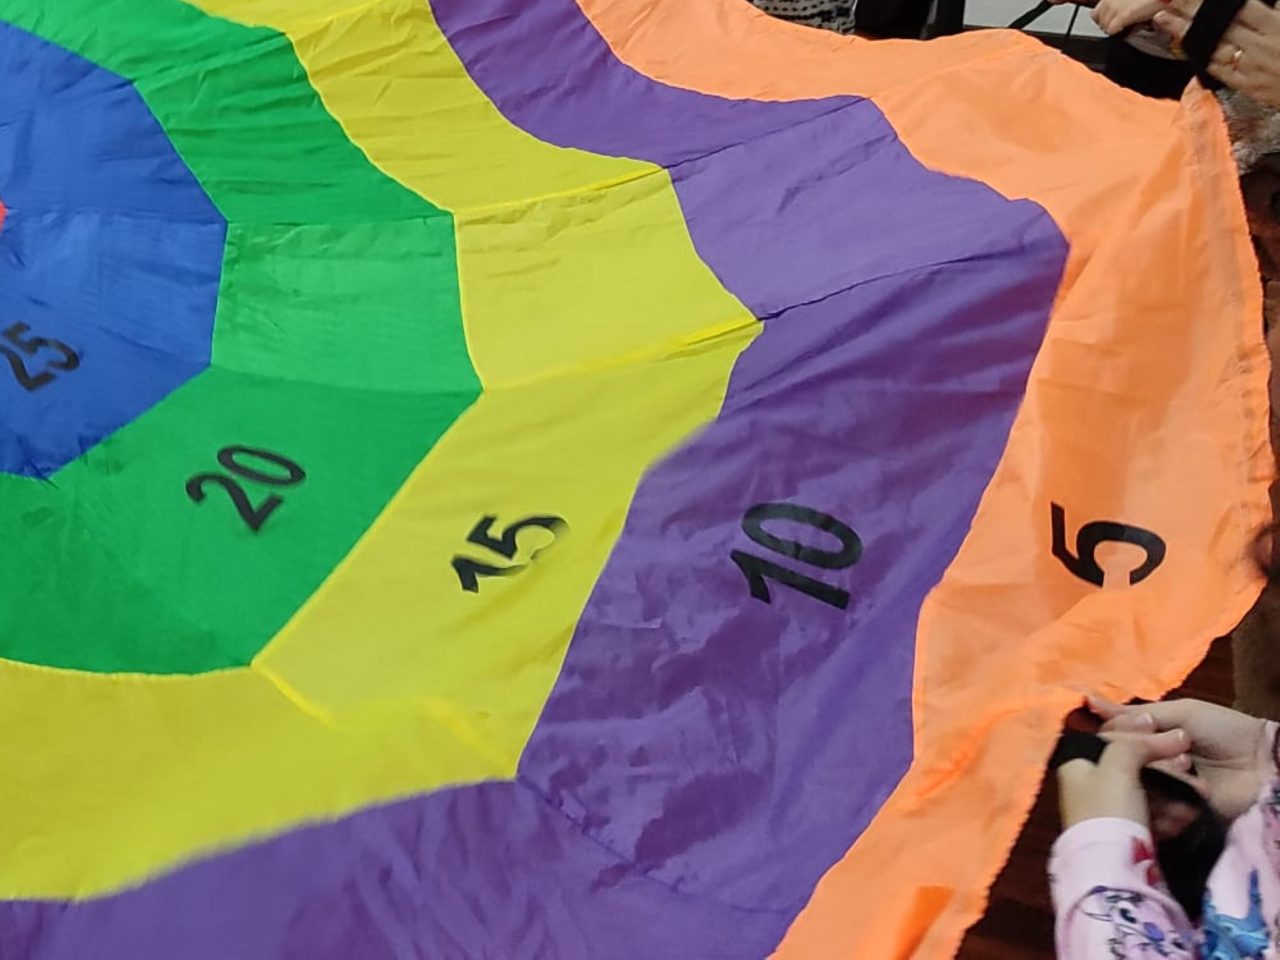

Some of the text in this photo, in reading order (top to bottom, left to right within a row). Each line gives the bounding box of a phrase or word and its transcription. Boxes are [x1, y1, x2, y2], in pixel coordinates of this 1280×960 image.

[185, 445, 306, 535] 20
[451, 514, 570, 593] 15
[730, 502, 863, 610] 10
[1050, 501, 1166, 587] 5
